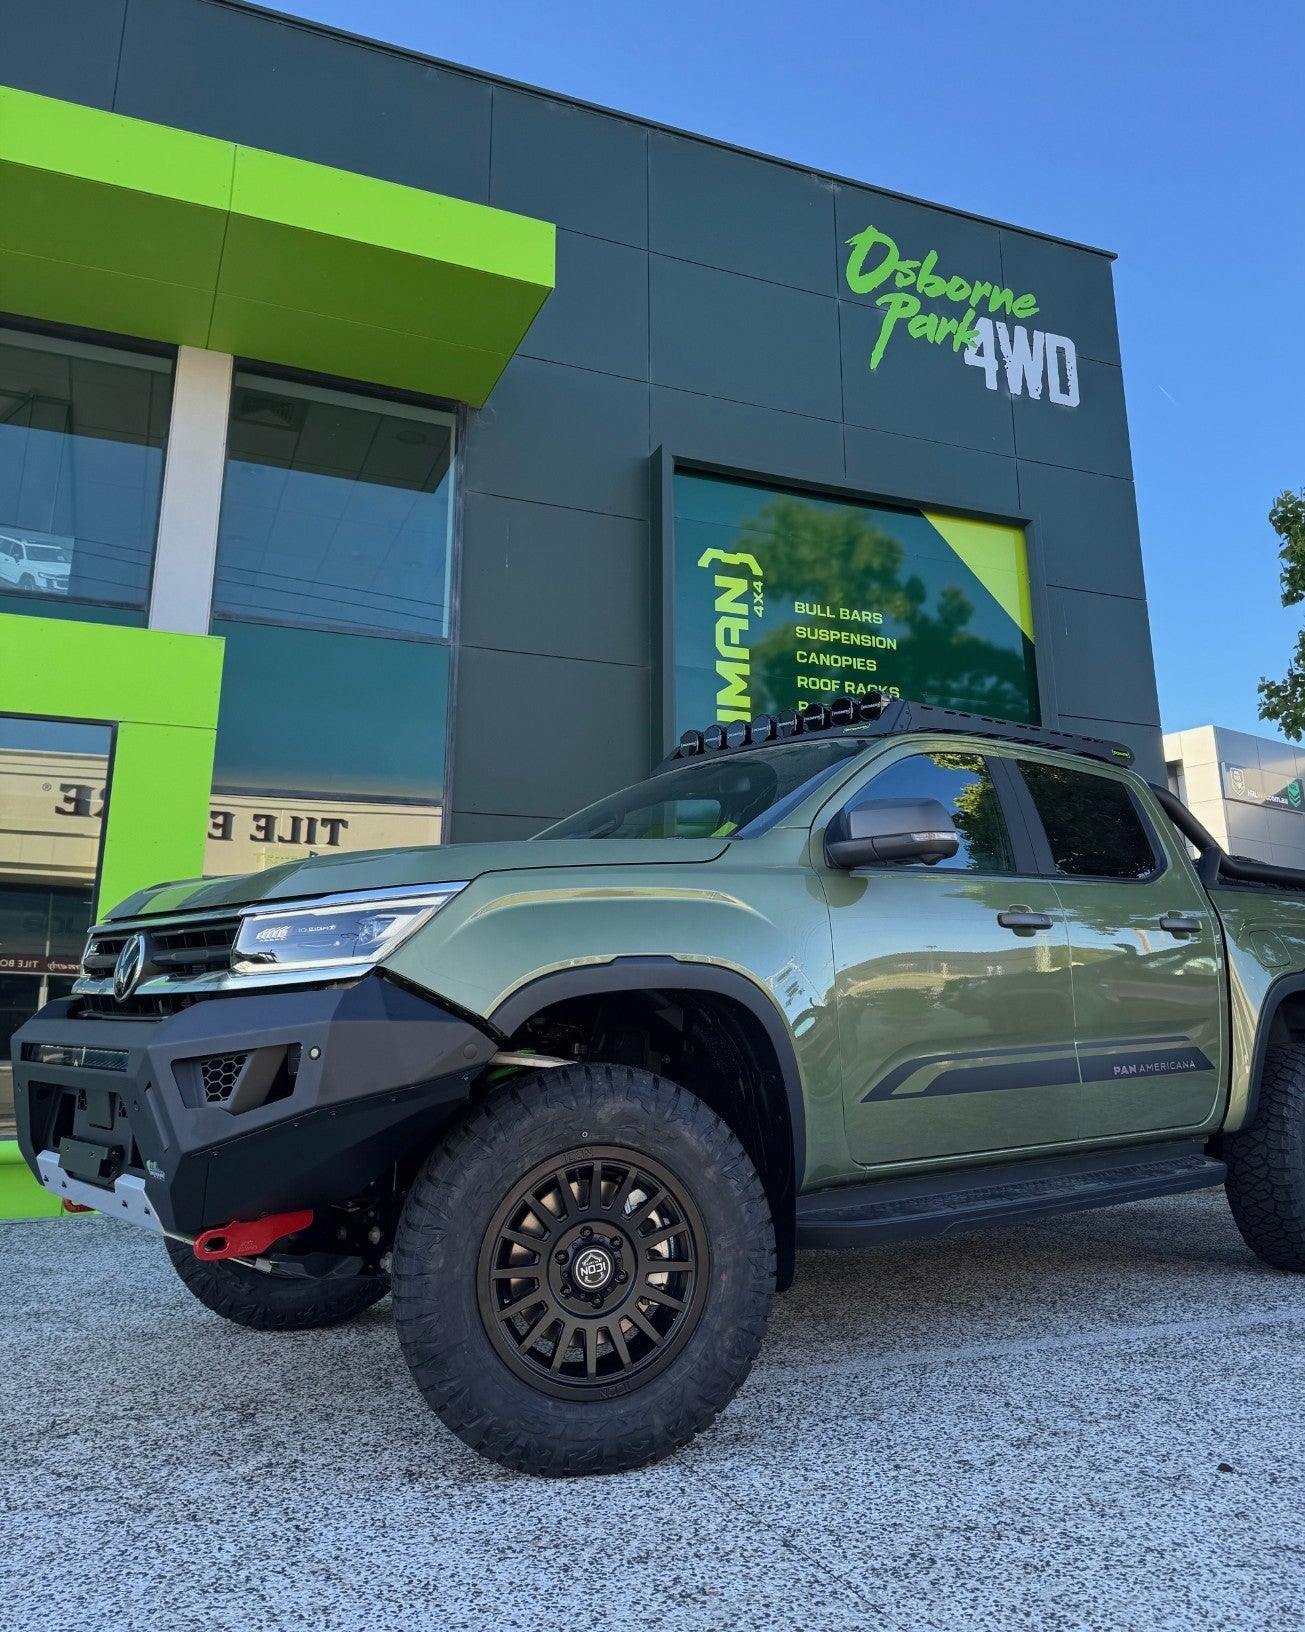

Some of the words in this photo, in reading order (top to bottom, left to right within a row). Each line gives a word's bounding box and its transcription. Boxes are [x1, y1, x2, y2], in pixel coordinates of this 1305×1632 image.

[844, 224, 1040, 319] Osborne
[869, 292, 981, 370] Park
[964, 317, 1080, 408] 4WD
[794, 601, 836, 619] BULL
[838, 607, 884, 625] BARS
[795, 625, 898, 651] SUSPENSION
[796, 650, 878, 671] CANOPIES
[797, 675, 840, 692] ROOF
[1113, 1064, 1137, 1076] PAN
[1139, 1060, 1196, 1073] AMERICANA
[580, 1261, 607, 1277] ICON
